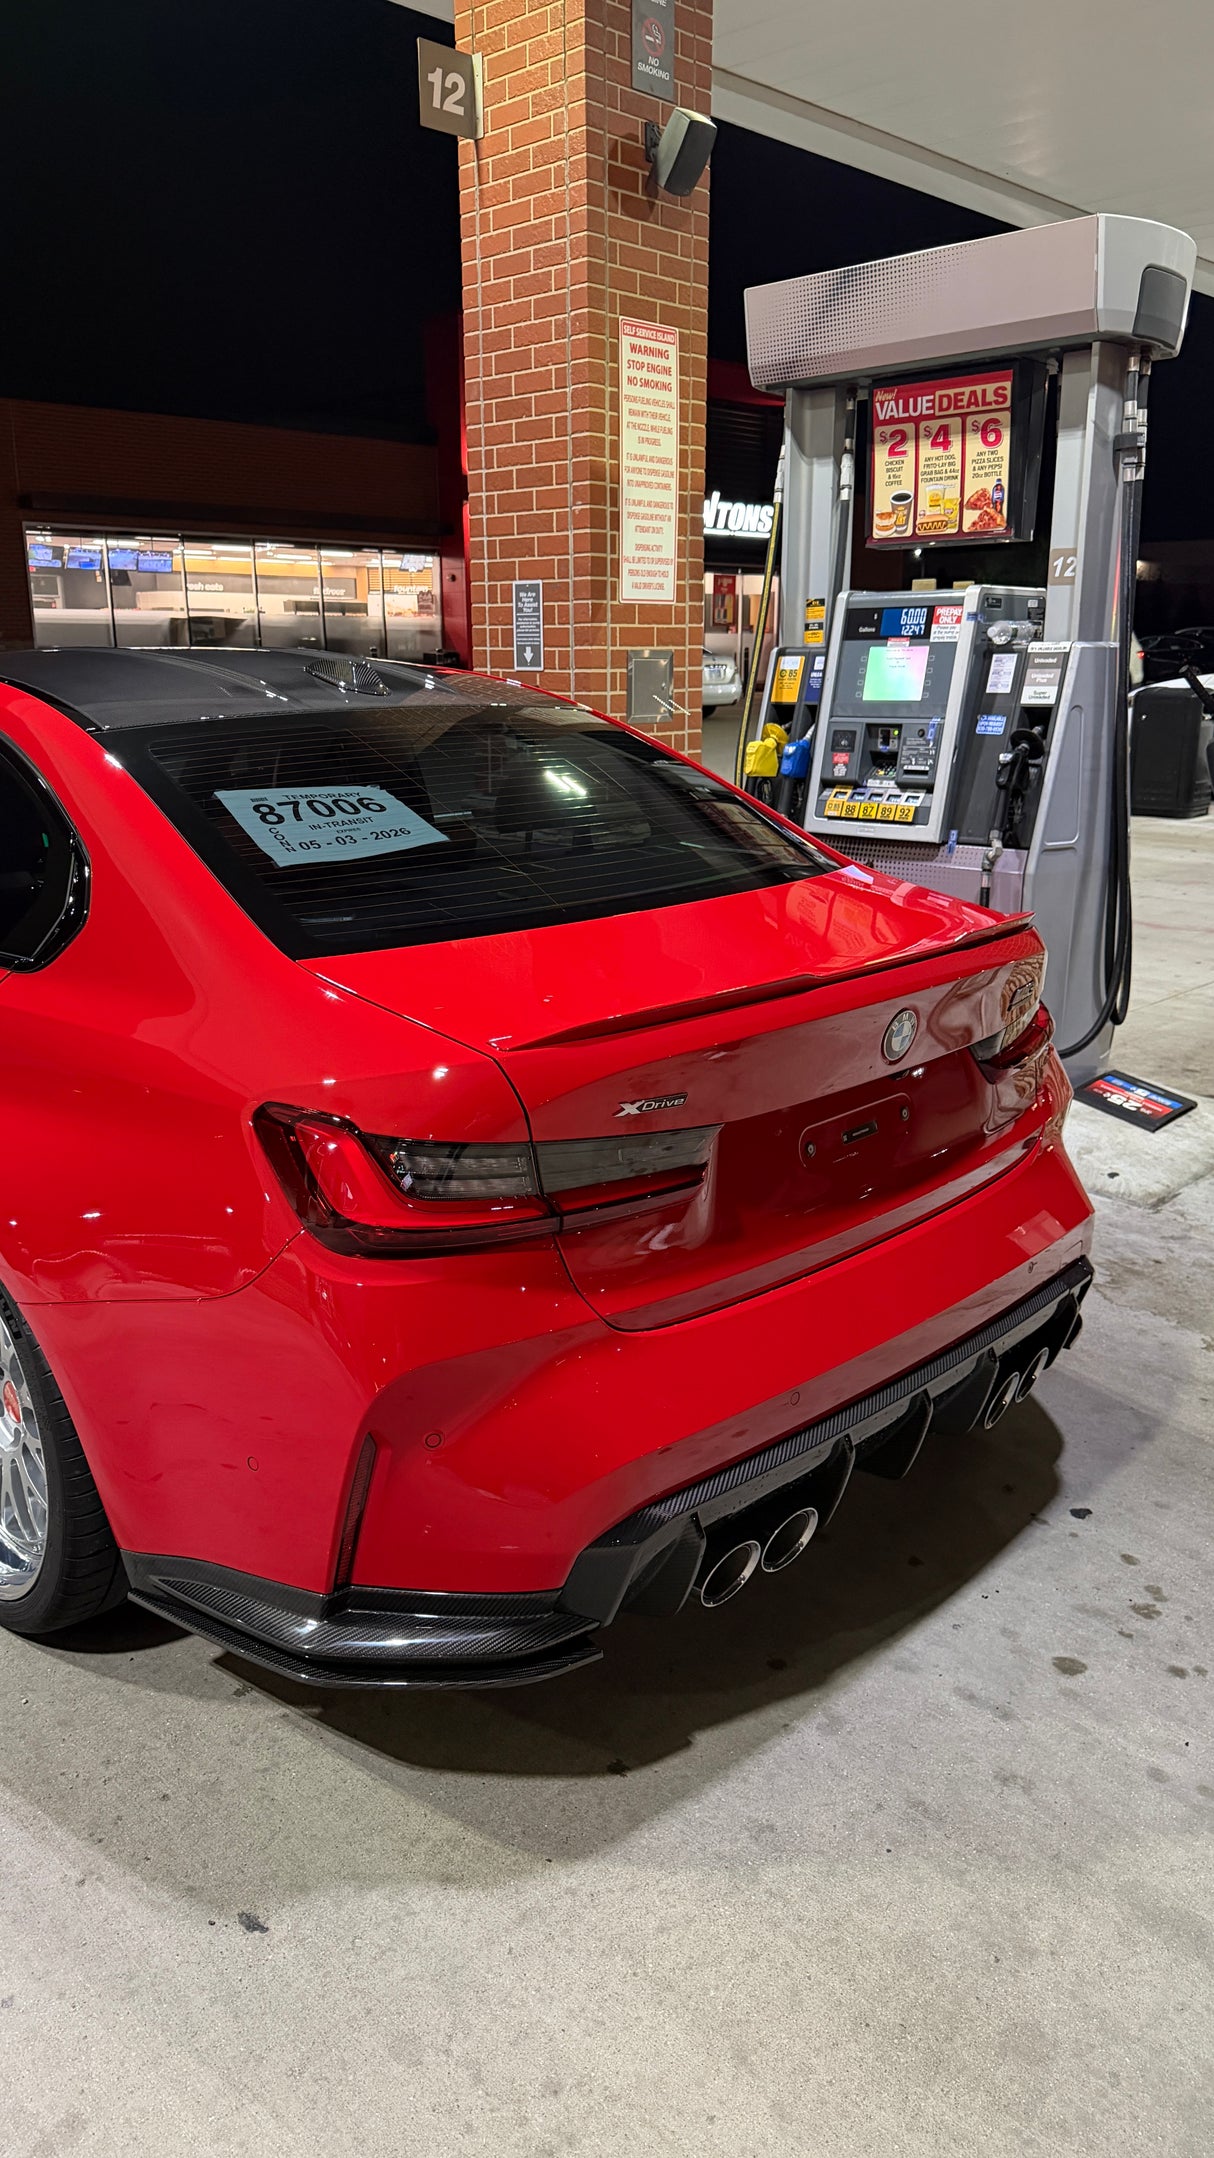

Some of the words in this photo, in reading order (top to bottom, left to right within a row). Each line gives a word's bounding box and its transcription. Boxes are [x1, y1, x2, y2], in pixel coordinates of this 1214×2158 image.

[648, 56, 660, 67] NO
[637, 62, 670, 81] SMOKING
[427, 66, 466, 116] 12
[623, 325, 635, 336] SELF
[636, 327, 657, 340] SERVICE
[657, 331, 675, 344] ISLAND
[629, 342, 670, 360] WARNING
[627, 359, 645, 372] STOP
[647, 364, 672, 377] ENGINE
[627, 375, 638, 387] NO
[639, 379, 672, 393] SMOKING
[875, 388, 898, 402] New!
[875, 395, 934, 421] VALUE
[937, 386, 1008, 413] DEALS
[923, 423, 953, 453] $4
[971, 417, 1004, 449] $6
[879, 428, 908, 459] $2
[885, 459, 905, 467] CHICKEN
[971, 457, 986, 465] PIZZA
[920, 469, 933, 477] GRAB
[983, 470, 1002, 478] BOTTLE
[1052, 556, 1077, 578] 12
[936, 608, 963, 617] PREPAY
[938, 616, 958, 625] ONLY
[282, 791, 362, 801] TEMPORARY
[252, 797, 387, 825] 87006
[845, 804, 857, 814] 88
[862, 805, 875, 815] 87
[880, 807, 893, 816] 89
[899, 808, 911, 818] 92
[308, 816, 374, 831] IN-TRANSIT
[268, 827, 297, 853] CONN
[298, 839, 322, 852] 05
[336, 834, 358, 846] 03
[369, 827, 412, 842] 2026
